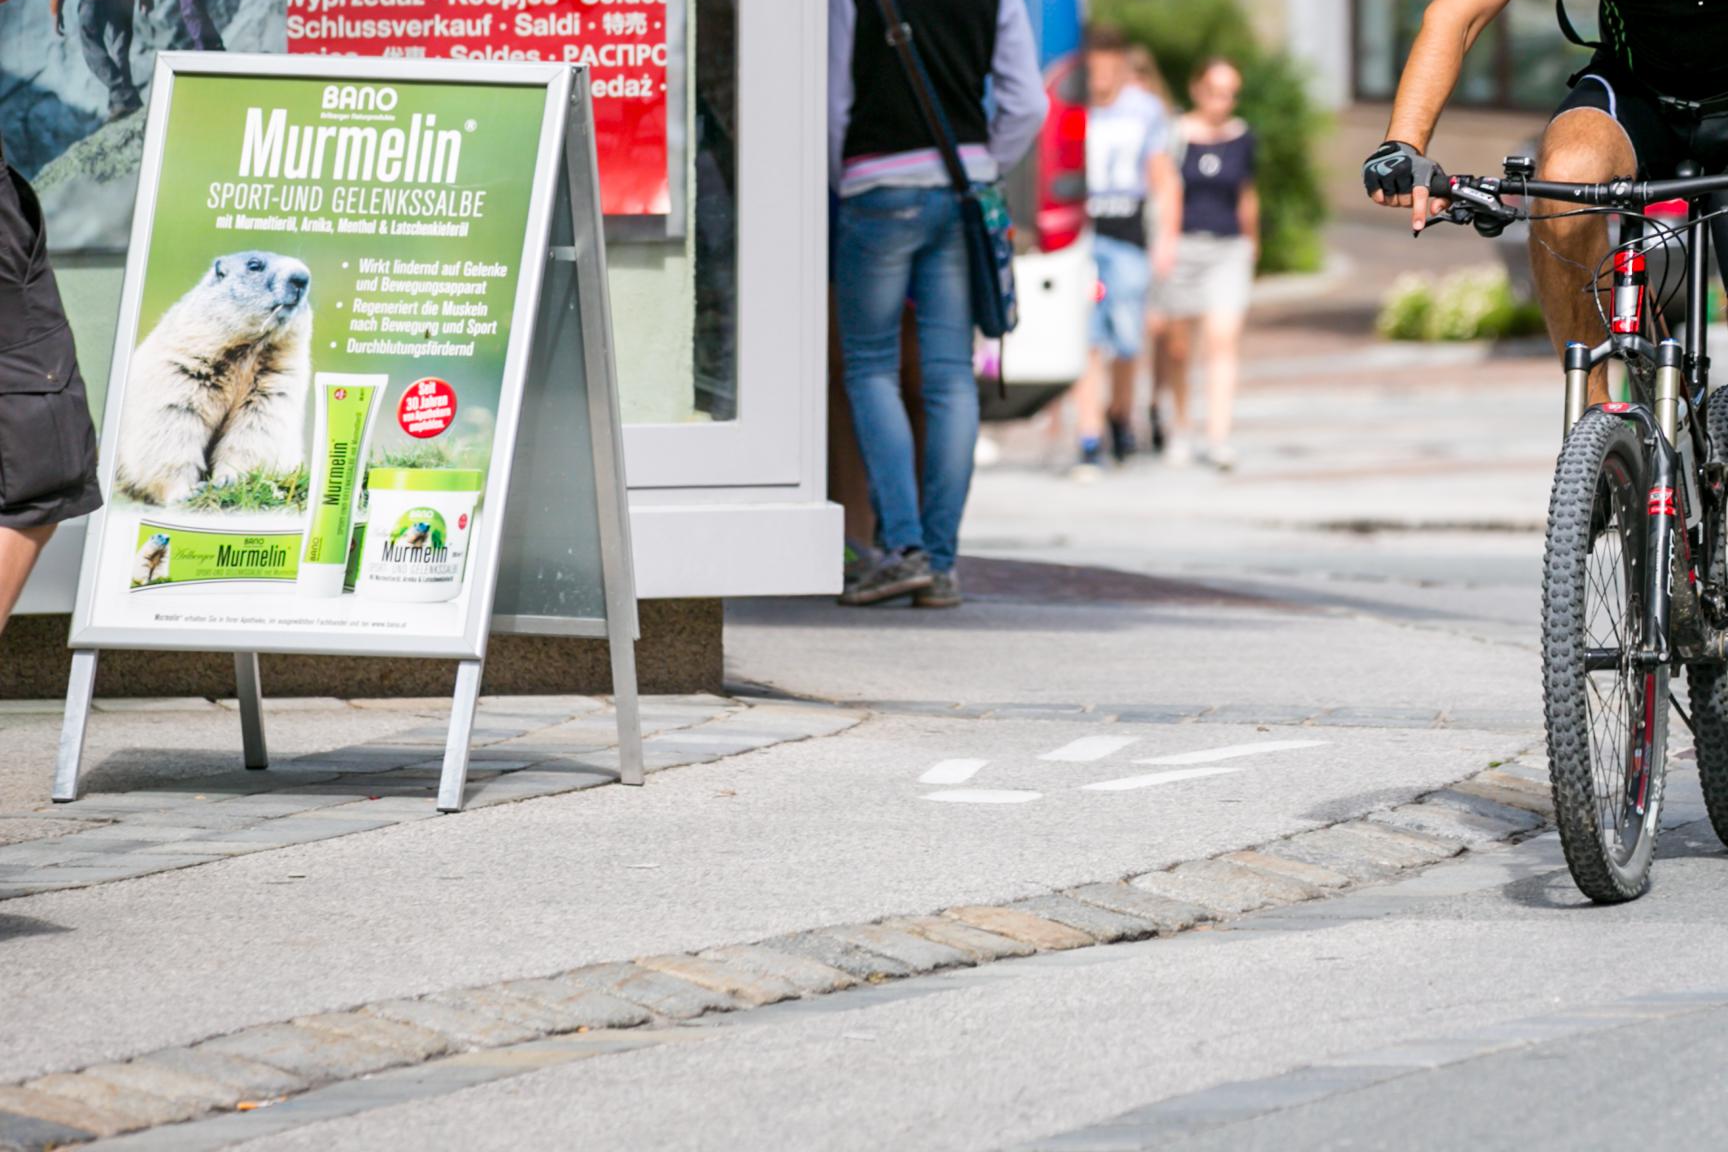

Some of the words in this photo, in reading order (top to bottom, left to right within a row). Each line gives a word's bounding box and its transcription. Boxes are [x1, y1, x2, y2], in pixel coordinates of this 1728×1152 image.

[287, 14, 493, 39] Schlussverkauf
[514, 13, 581, 38] Saldi
[321, 85, 398, 111] BANO
[207, 182, 324, 212] SPORT-UND
[331, 187, 487, 217] GELENKSSALBE
[379, 219, 388, 235] &
[359, 258, 390, 274] Wirkt
[393, 259, 439, 276] lindernd
[441, 261, 461, 276] auf
[464, 261, 508, 278] Gelenke
[356, 277, 378, 292] und
[381, 277, 487, 296] Bewegungsapparat
[353, 298, 418, 316] Regeneriert
[421, 300, 438, 316] die
[442, 301, 488, 316] Muskeln
[350, 317, 377, 332] nach
[381, 317, 439, 336] Bewegung
[442, 319, 464, 334] und
[467, 318, 498, 337] Sport
[346, 338, 475, 358] Durchblutungsfördernd
[322, 441, 348, 506] Murmelin
[216, 544, 287, 567] Murmelin
[381, 540, 448, 564] Murmelin
